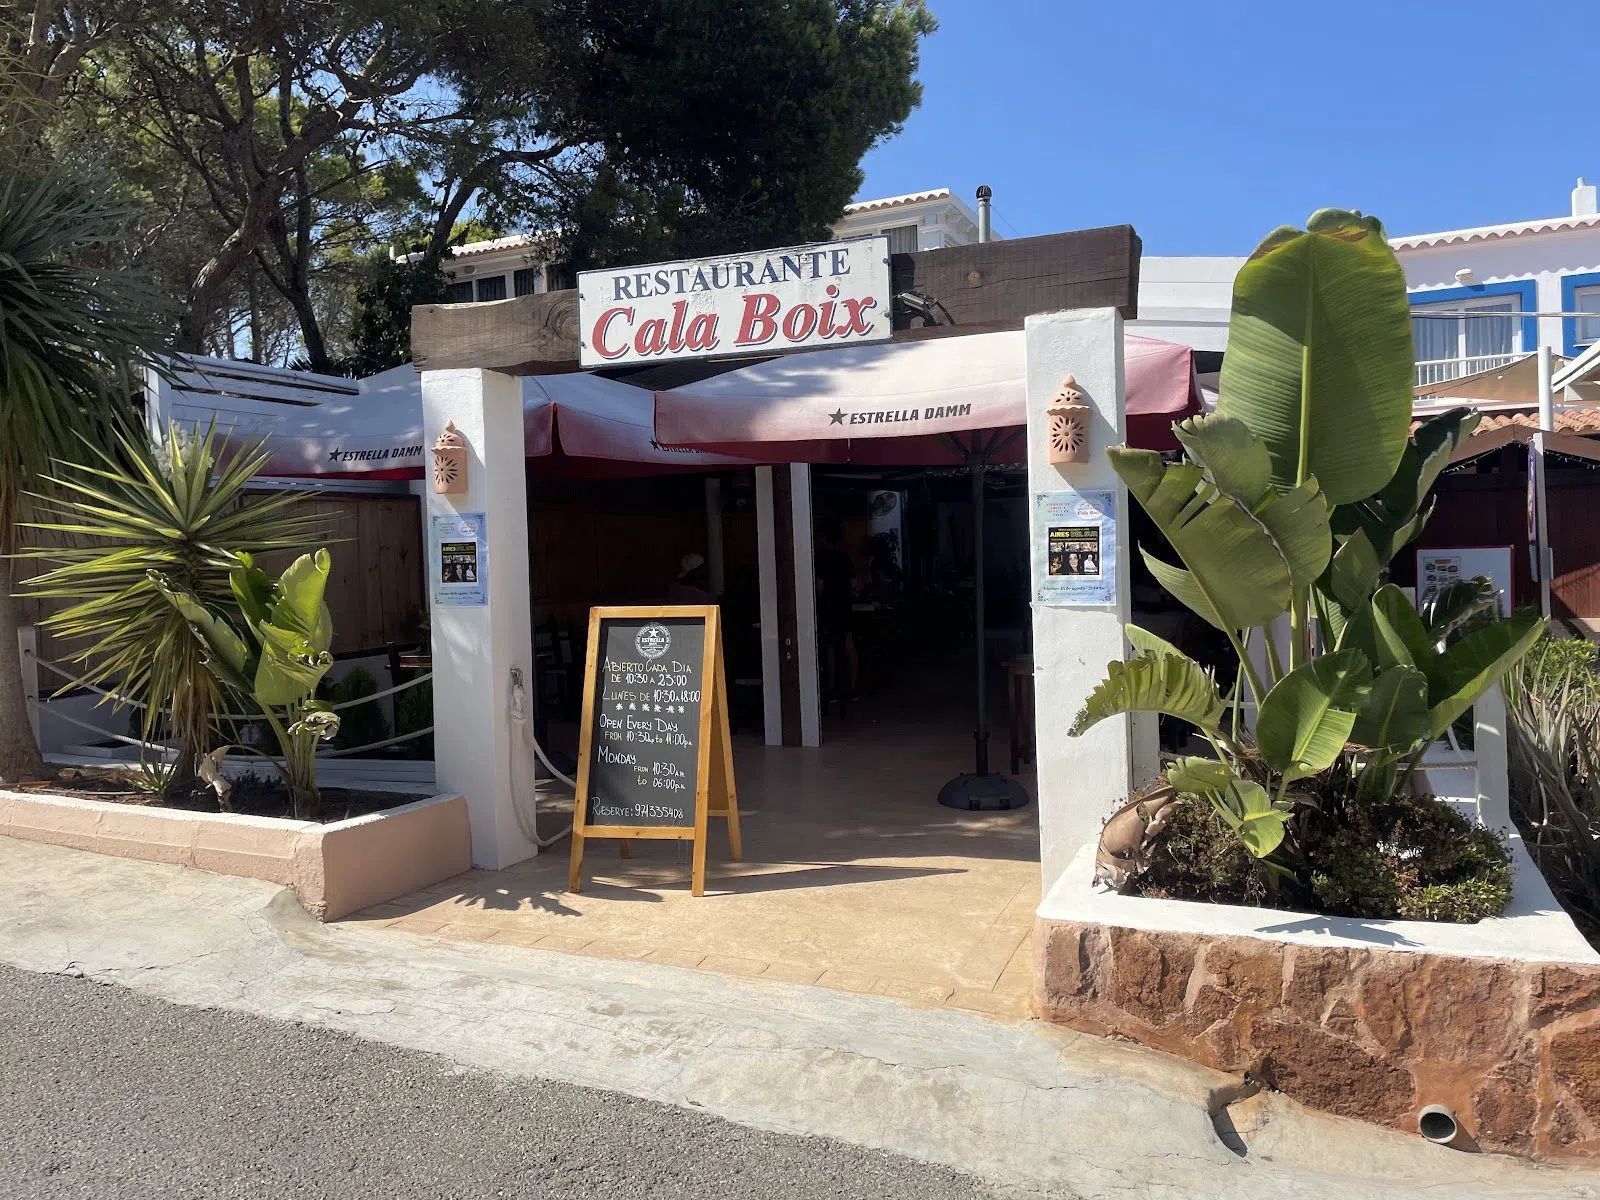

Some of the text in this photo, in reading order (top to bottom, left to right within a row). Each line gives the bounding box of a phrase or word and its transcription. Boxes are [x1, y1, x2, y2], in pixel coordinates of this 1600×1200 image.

[613, 248, 850, 301] RESTAURANTE
[592, 284, 877, 359] Cala Boix
[849, 403, 972, 425] ESTRELLA DAMM
[341, 445, 423, 462] ESTRELLA DAMM
[611, 673, 621, 683] DE
[625, 673, 648, 684] 10:30
[657, 673, 688, 687] 23:00
[639, 692, 651, 701] DE
[599, 713, 623, 729] OPEN
[654, 717, 679, 732] DAY
[597, 744, 637, 765] MONDAY
[636, 775, 648, 785] to
